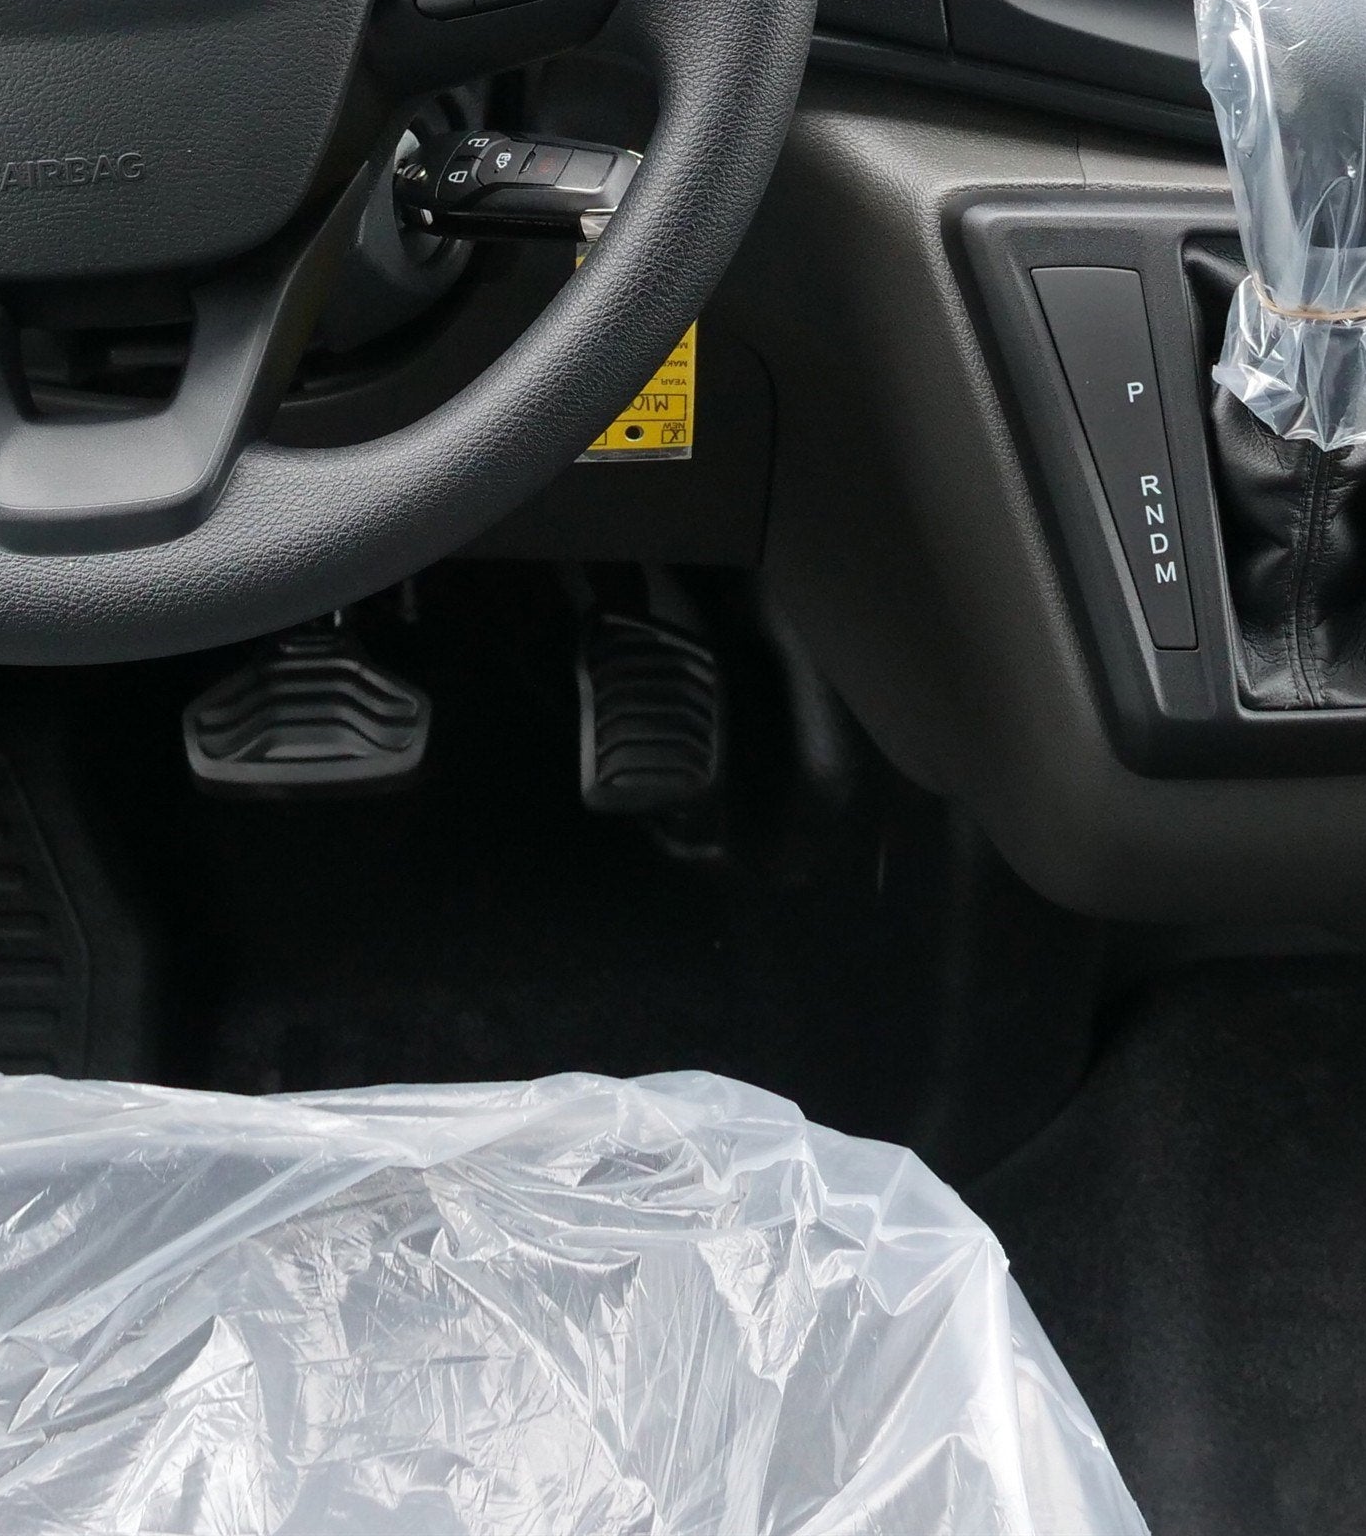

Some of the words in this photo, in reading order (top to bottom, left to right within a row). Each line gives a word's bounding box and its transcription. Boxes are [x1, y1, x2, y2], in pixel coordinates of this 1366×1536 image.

[0, 151, 146, 192] AIRBAG
[660, 378, 688, 386] YEAR
[1127, 381, 1145, 403] P
[663, 421, 686, 429] NEW
[1140, 475, 1162, 497] R
[1145, 504, 1165, 525] N
[1150, 533, 1169, 554] D
[1155, 561, 1177, 583] M
